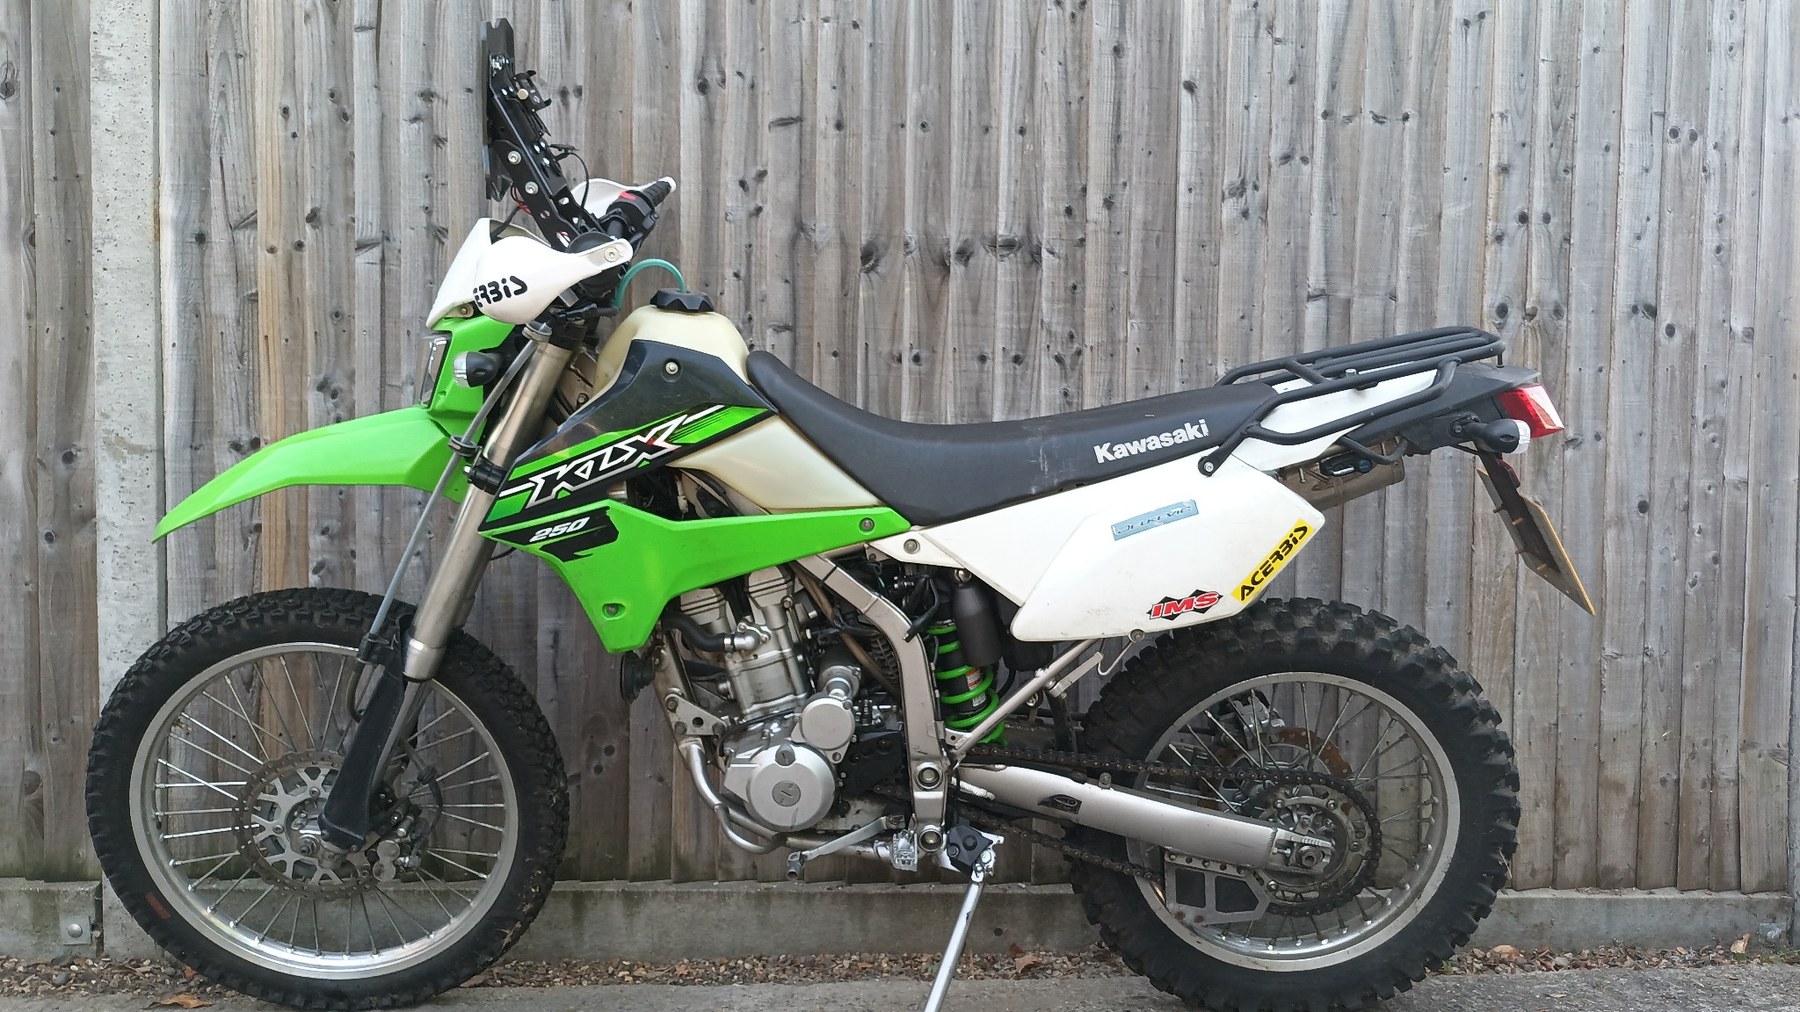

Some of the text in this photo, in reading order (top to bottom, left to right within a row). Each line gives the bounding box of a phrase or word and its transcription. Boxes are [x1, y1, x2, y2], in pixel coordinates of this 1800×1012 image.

[1093, 418, 1210, 464] Kawasaki
[529, 516, 592, 542] 250
[1149, 591, 1220, 620] IMS
